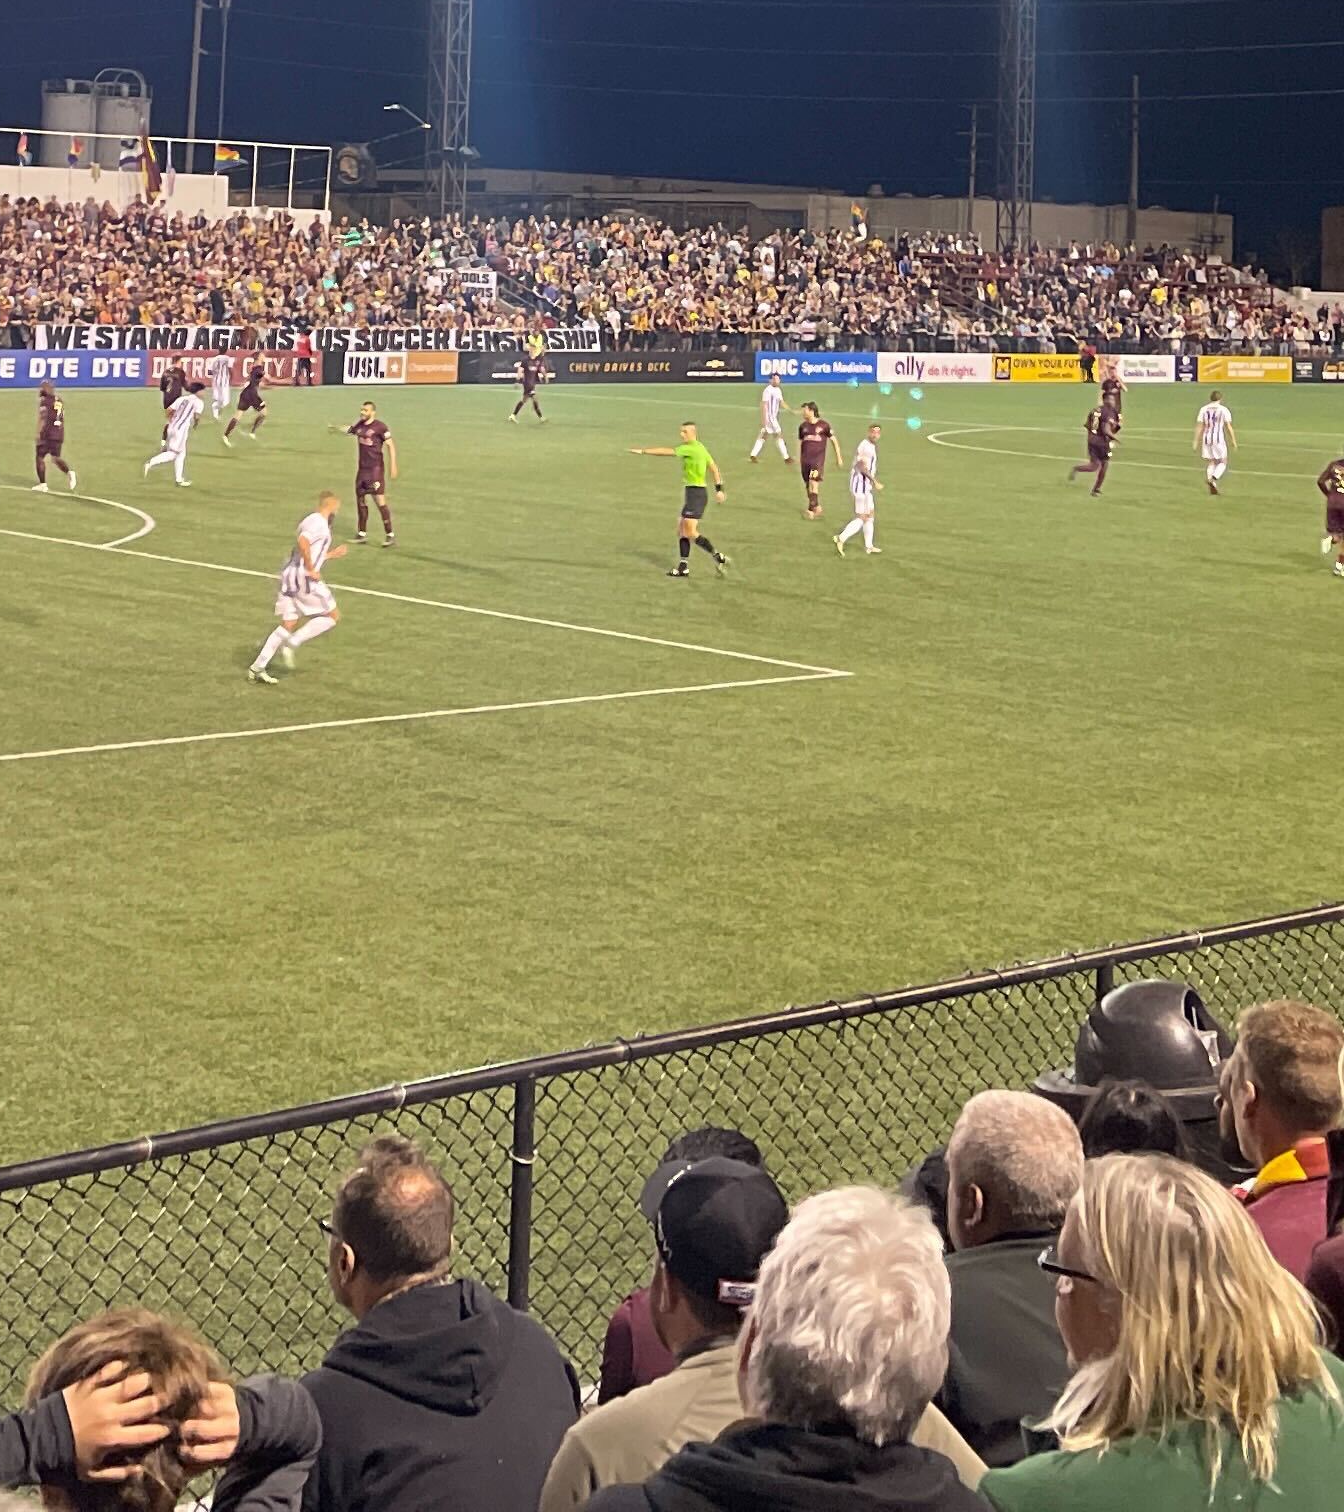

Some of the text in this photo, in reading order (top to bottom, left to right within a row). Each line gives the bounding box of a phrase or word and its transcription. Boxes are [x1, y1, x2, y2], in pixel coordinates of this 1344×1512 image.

[46, 325, 90, 350] WE
[94, 325, 188, 350] STAND
[315, 328, 350, 352] US
[354, 327, 450, 351] SOCCER
[28, 357, 80, 379] DTE
[91, 357, 141, 379] DTE
[347, 355, 385, 379] USL
[568, 361, 600, 373] CHEVY
[603, 361, 643, 373] DRIVES
[760, 358, 799, 376] DMC
[800, 361, 831, 375] Sports
[832, 361, 873, 374] Medicine
[894, 355, 926, 380] ally
[927, 364, 940, 377] do
[1013, 358, 1036, 368] OWN
[1038, 358, 1062, 368] YOUR
